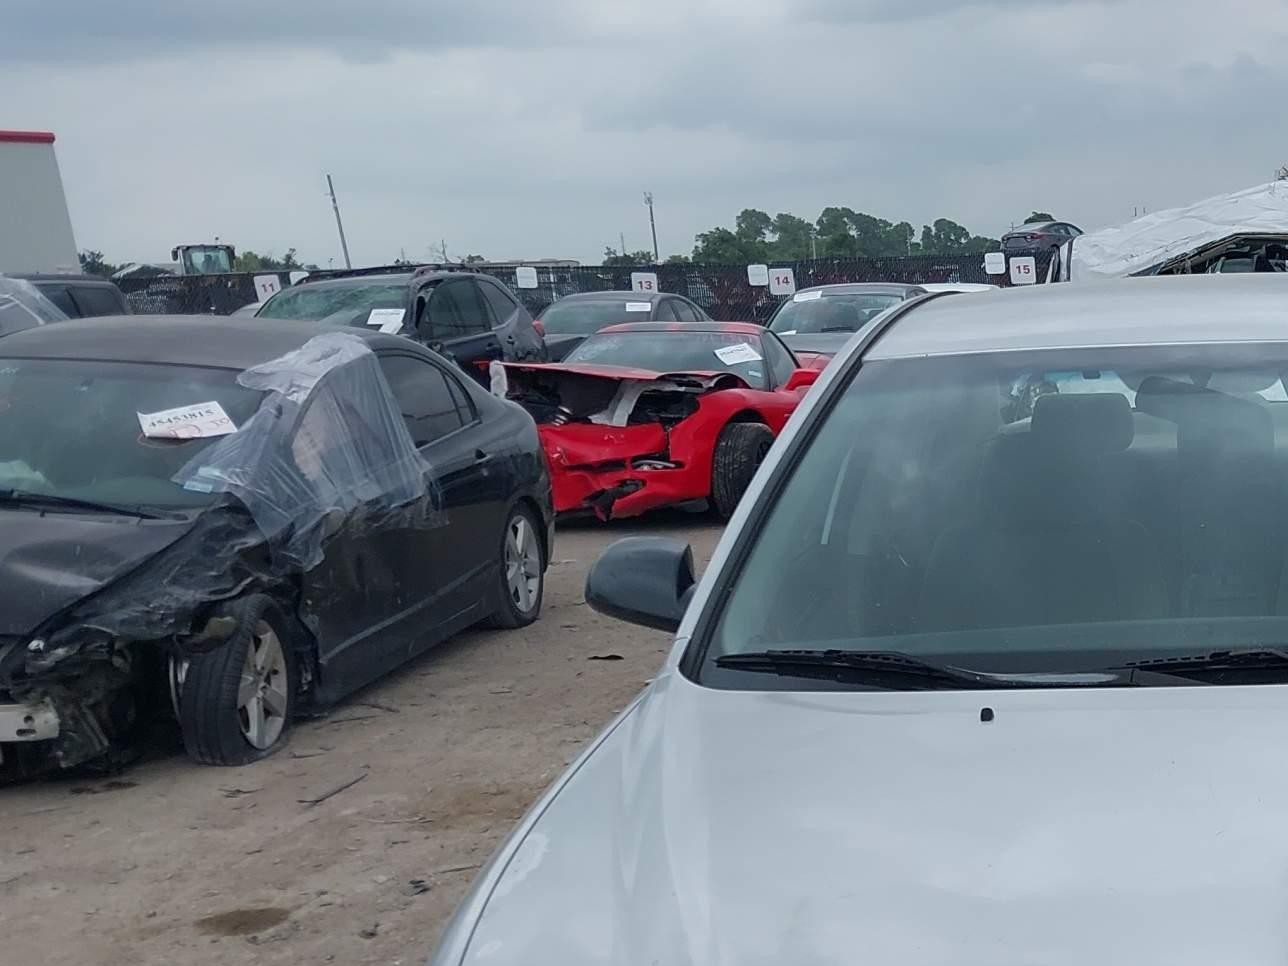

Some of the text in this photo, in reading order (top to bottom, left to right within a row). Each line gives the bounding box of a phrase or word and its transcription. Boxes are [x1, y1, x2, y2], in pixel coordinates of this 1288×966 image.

[1015, 264, 1031, 275] 15
[637, 280, 653, 291] 13
[774, 276, 791, 286] 14
[260, 282, 276, 293] 11
